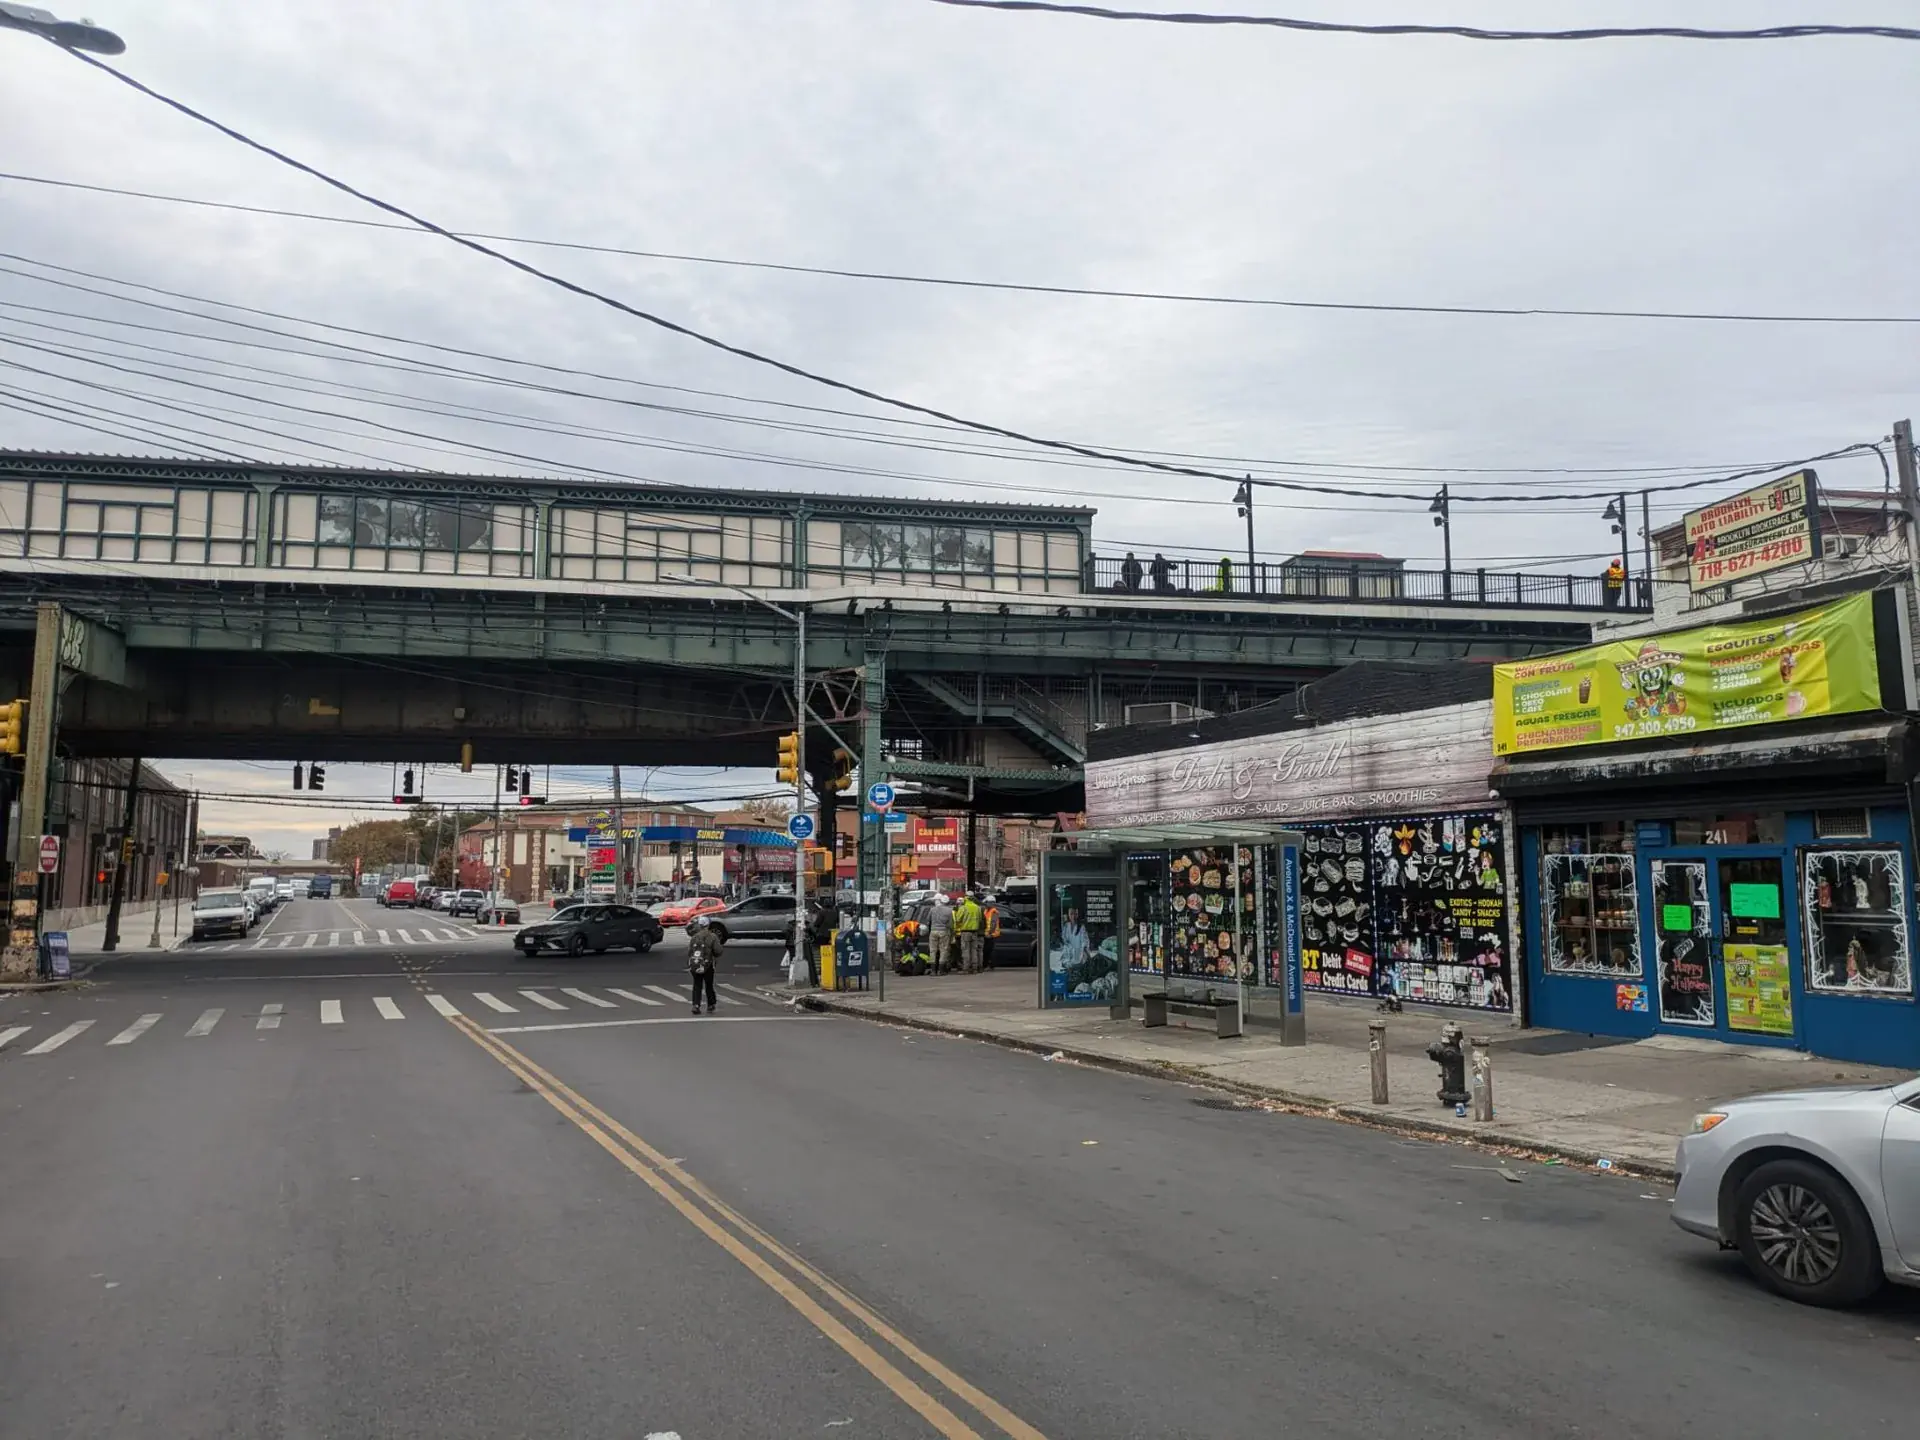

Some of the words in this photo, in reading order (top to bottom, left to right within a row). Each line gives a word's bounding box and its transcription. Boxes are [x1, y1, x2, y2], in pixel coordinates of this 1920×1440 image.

[1700, 496, 1752, 522] BROOKLYN
[1691, 521, 1716, 536] AUTO
[1719, 502, 1766, 527] LIABILITY
[1717, 526, 1751, 546] BROOKLYN
[1751, 513, 1790, 535] BROKERAGE
[1697, 536, 1803, 583] 718-627-4200
[1706, 633, 1776, 653] ESQUITES
[1514, 669, 1535, 680] CON
[1539, 662, 1576, 676] FRUTA
[1719, 663, 1762, 676] MANGO
[1520, 686, 1573, 700] CHOCOLATE
[1713, 692, 1784, 710] LICUADOS
[1516, 716, 1550, 727] AGUAS
[1553, 709, 1597, 721] FRESCAS
[1614, 716, 1696, 738] 347.300.4950
[1171, 756, 1226, 792] Deli
[1231, 756, 1266, 800] &
[1271, 740, 1348, 783] Grill
[1118, 812, 1165, 825] SANDWICHES
[1173, 809, 1202, 820] DRINKS
[1211, 806, 1247, 817] SNACKS
[1256, 802, 1289, 813] SALAD
[1299, 798, 1329, 811] JUICE
[1332, 796, 1356, 807] BAR
[1369, 788, 1438, 805] SMOOTHIES
[696, 829, 725, 840] SUNOCO
[918, 828, 933, 836] CAR
[933, 828, 954, 836] WASH
[1705, 829, 1729, 844] 241
[917, 843, 927, 852] OIL
[928, 843, 956, 852] CHANGE
[1285, 858, 1293, 894] Avenue
[1286, 895, 1294, 903] X
[1286, 904, 1294, 912] &
[1449, 898, 1473, 907] EXOTICS
[1477, 899, 1503, 907] HOOKAH
[1452, 908, 1472, 916] CANDY
[1477, 909, 1501, 917] SNACKS
[1459, 918, 1471, 926] ATM
[1477, 919, 1495, 927] MORE
[1286, 914, 1296, 963] McDonald
[1302, 948, 1320, 970] BT
[1322, 952, 1342, 969] Debit
[1287, 964, 1296, 1000] Avenue
[1322, 971, 1346, 988] Credit
[1346, 973, 1369, 991] Cards
